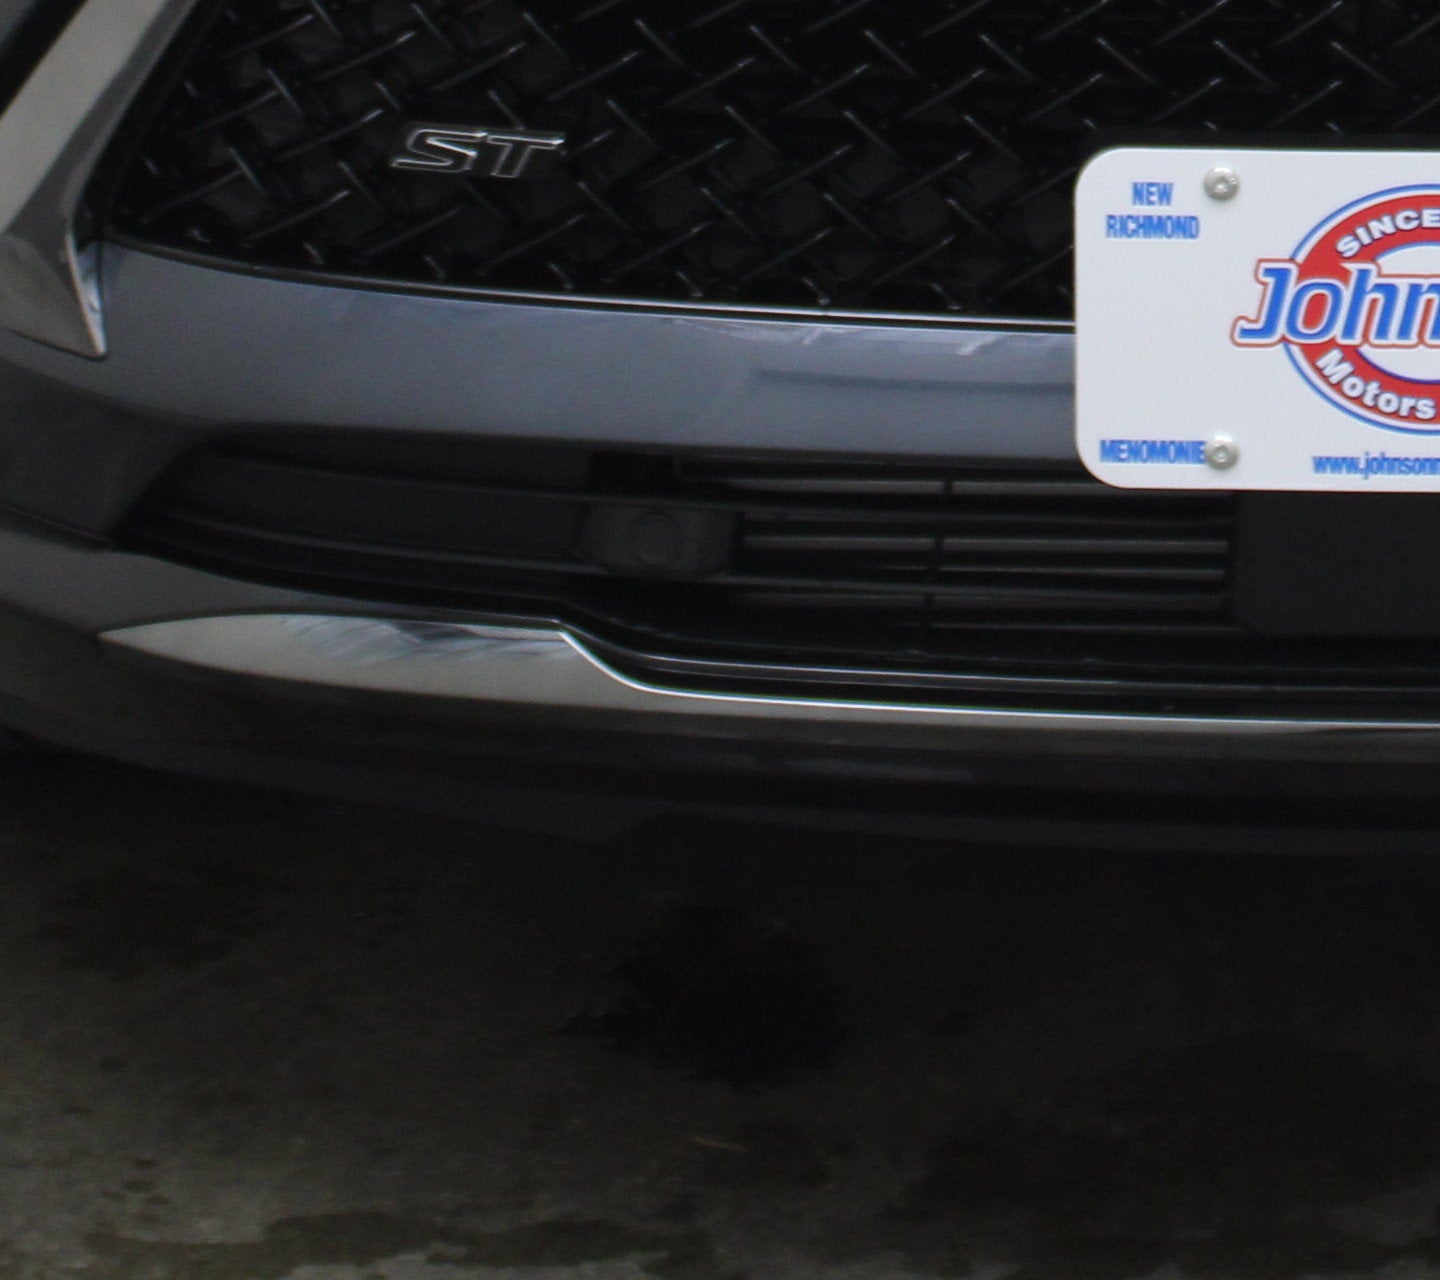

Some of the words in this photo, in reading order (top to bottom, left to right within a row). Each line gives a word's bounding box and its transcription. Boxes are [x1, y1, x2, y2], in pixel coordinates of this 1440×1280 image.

[391, 128, 565, 179] ST
[1131, 181, 1174, 207] NEW
[1105, 214, 1200, 240] RICHMOND
[1315, 347, 1437, 420] Motors
[1100, 439, 1207, 465] MENOMONIE
